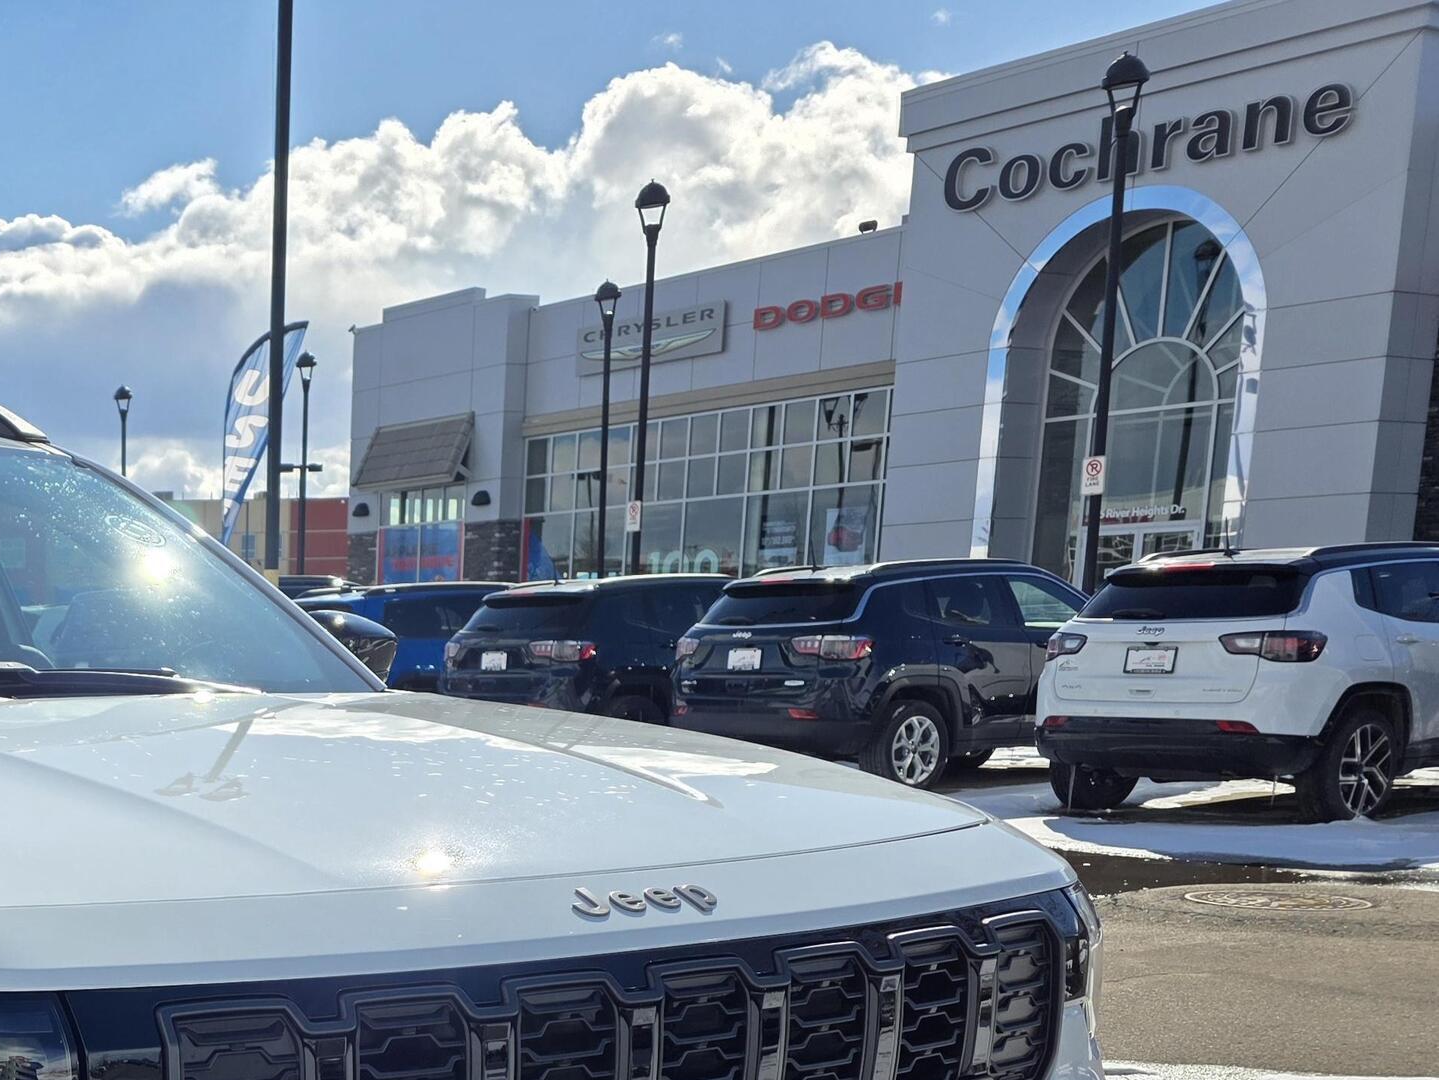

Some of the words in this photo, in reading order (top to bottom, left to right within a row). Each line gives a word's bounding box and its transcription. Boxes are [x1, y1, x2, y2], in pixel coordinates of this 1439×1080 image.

[943, 82, 1356, 213] Cochrane
[1105, 508, 1130, 518] River
[1131, 505, 1169, 518] Heights
[1170, 504, 1185, 514] Dr.
[571, 884, 718, 918] Jeep
